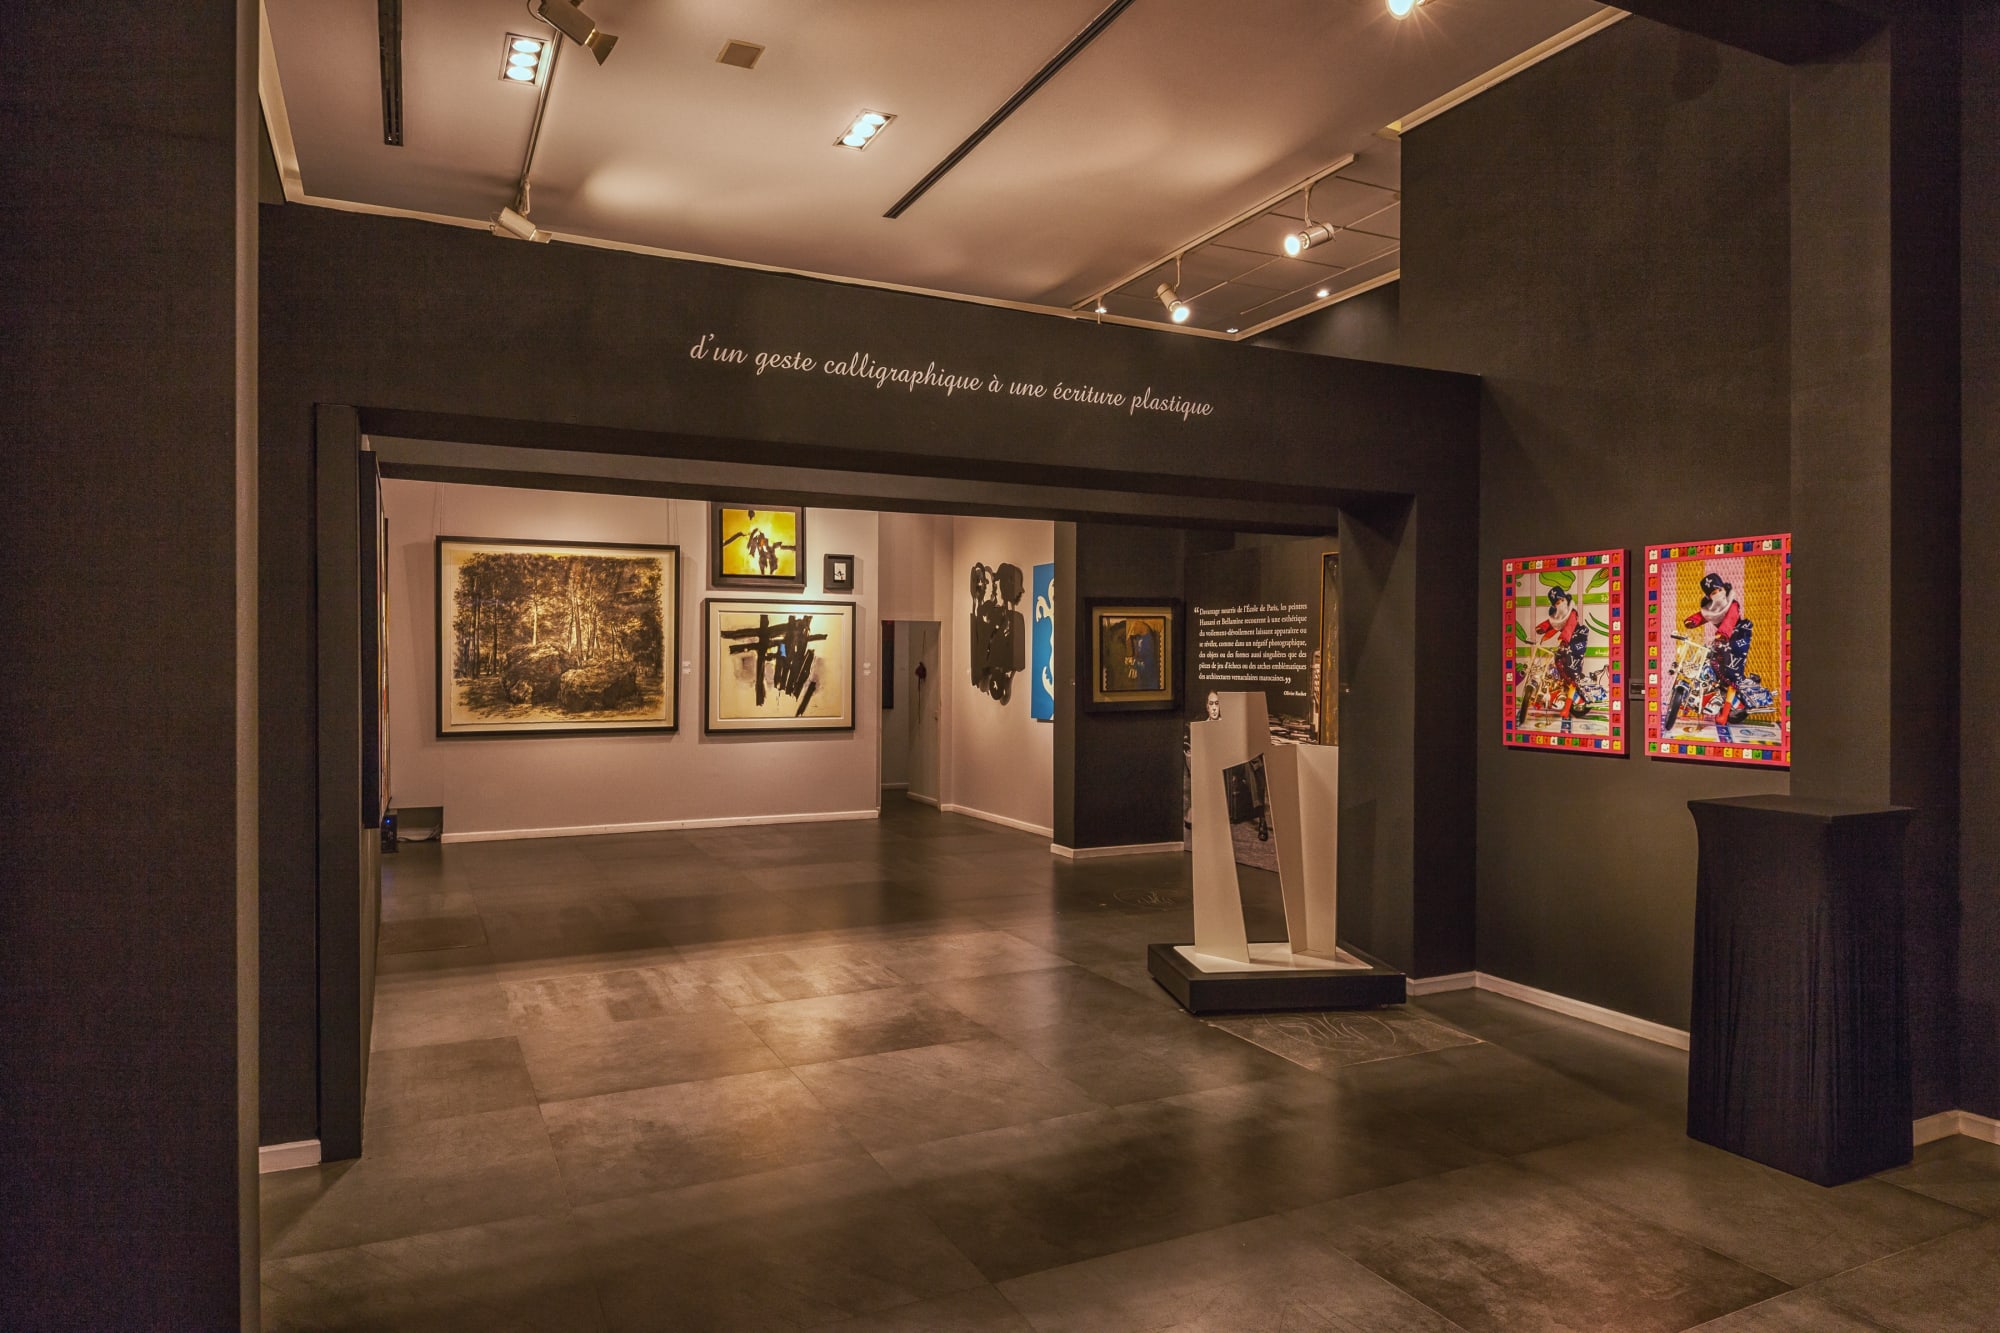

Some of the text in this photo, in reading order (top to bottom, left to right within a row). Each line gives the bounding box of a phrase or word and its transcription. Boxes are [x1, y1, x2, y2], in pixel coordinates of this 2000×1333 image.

[755, 351, 817, 376] geste
[823, 351, 984, 395] calligraphique
[988, 373, 1004, 393] à
[1009, 381, 1048, 398] une
[1053, 381, 1126, 407] écriture
[1130, 386, 1214, 421] plastique
